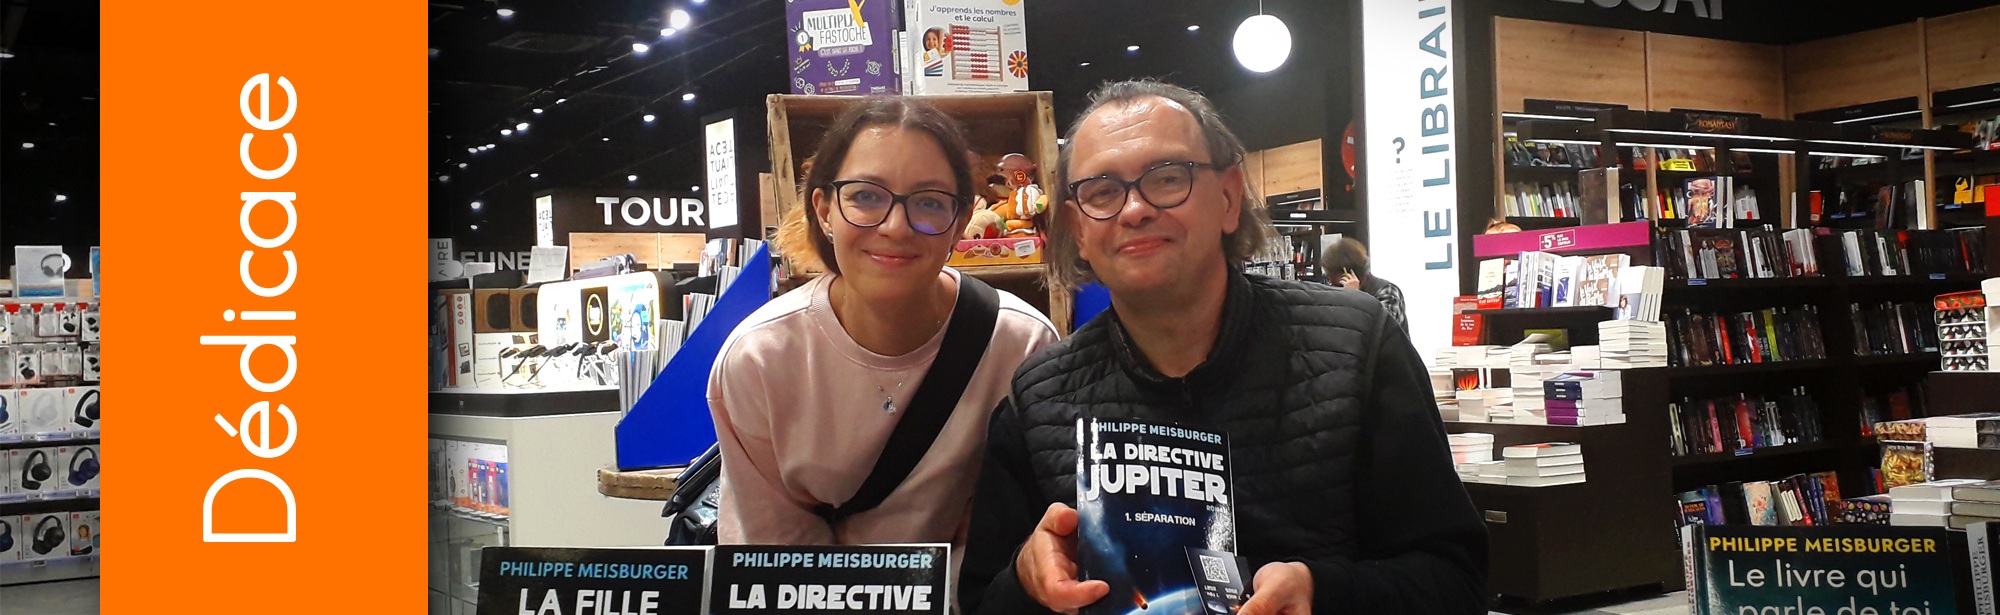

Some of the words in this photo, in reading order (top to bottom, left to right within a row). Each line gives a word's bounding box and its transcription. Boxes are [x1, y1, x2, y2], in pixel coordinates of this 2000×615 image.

[930, 5, 972, 15] J'apprends
[985, 8, 1017, 16] nombres
[819, 26, 867, 45] FASTOCHE
[1418, 0, 1450, 187] LIBRAI
[596, 196, 706, 227] TOUR
[1424, 208, 1453, 270] LE
[1091, 422, 1147, 434] PHILIPPE
[1149, 425, 1222, 445] MEISBURGER
[1090, 442, 1117, 460] LA
[1124, 443, 1224, 471] DIRECTIVE
[1086, 464, 1228, 504] JUPITER
[1125, 513, 1132, 522] 1.
[1135, 511, 1196, 526] SÉPARATION
[1709, 537, 1797, 552] PHILIPPE
[1804, 537, 1937, 553] MEISBURGER
[500, 561, 574, 577] PHILIPPE
[577, 563, 689, 579] MEISBURGER
[732, 552, 814, 568] PHILIPPE
[818, 553, 933, 569] MEISBURGER
[1728, 559, 1766, 588] Le
[1776, 559, 1845, 588] livre
[1856, 563, 1907, 596] qui
[518, 588, 562, 615] LA
[574, 590, 660, 615] FILLE
[729, 584, 766, 609] LA
[777, 584, 932, 610] DIRECTIVE
